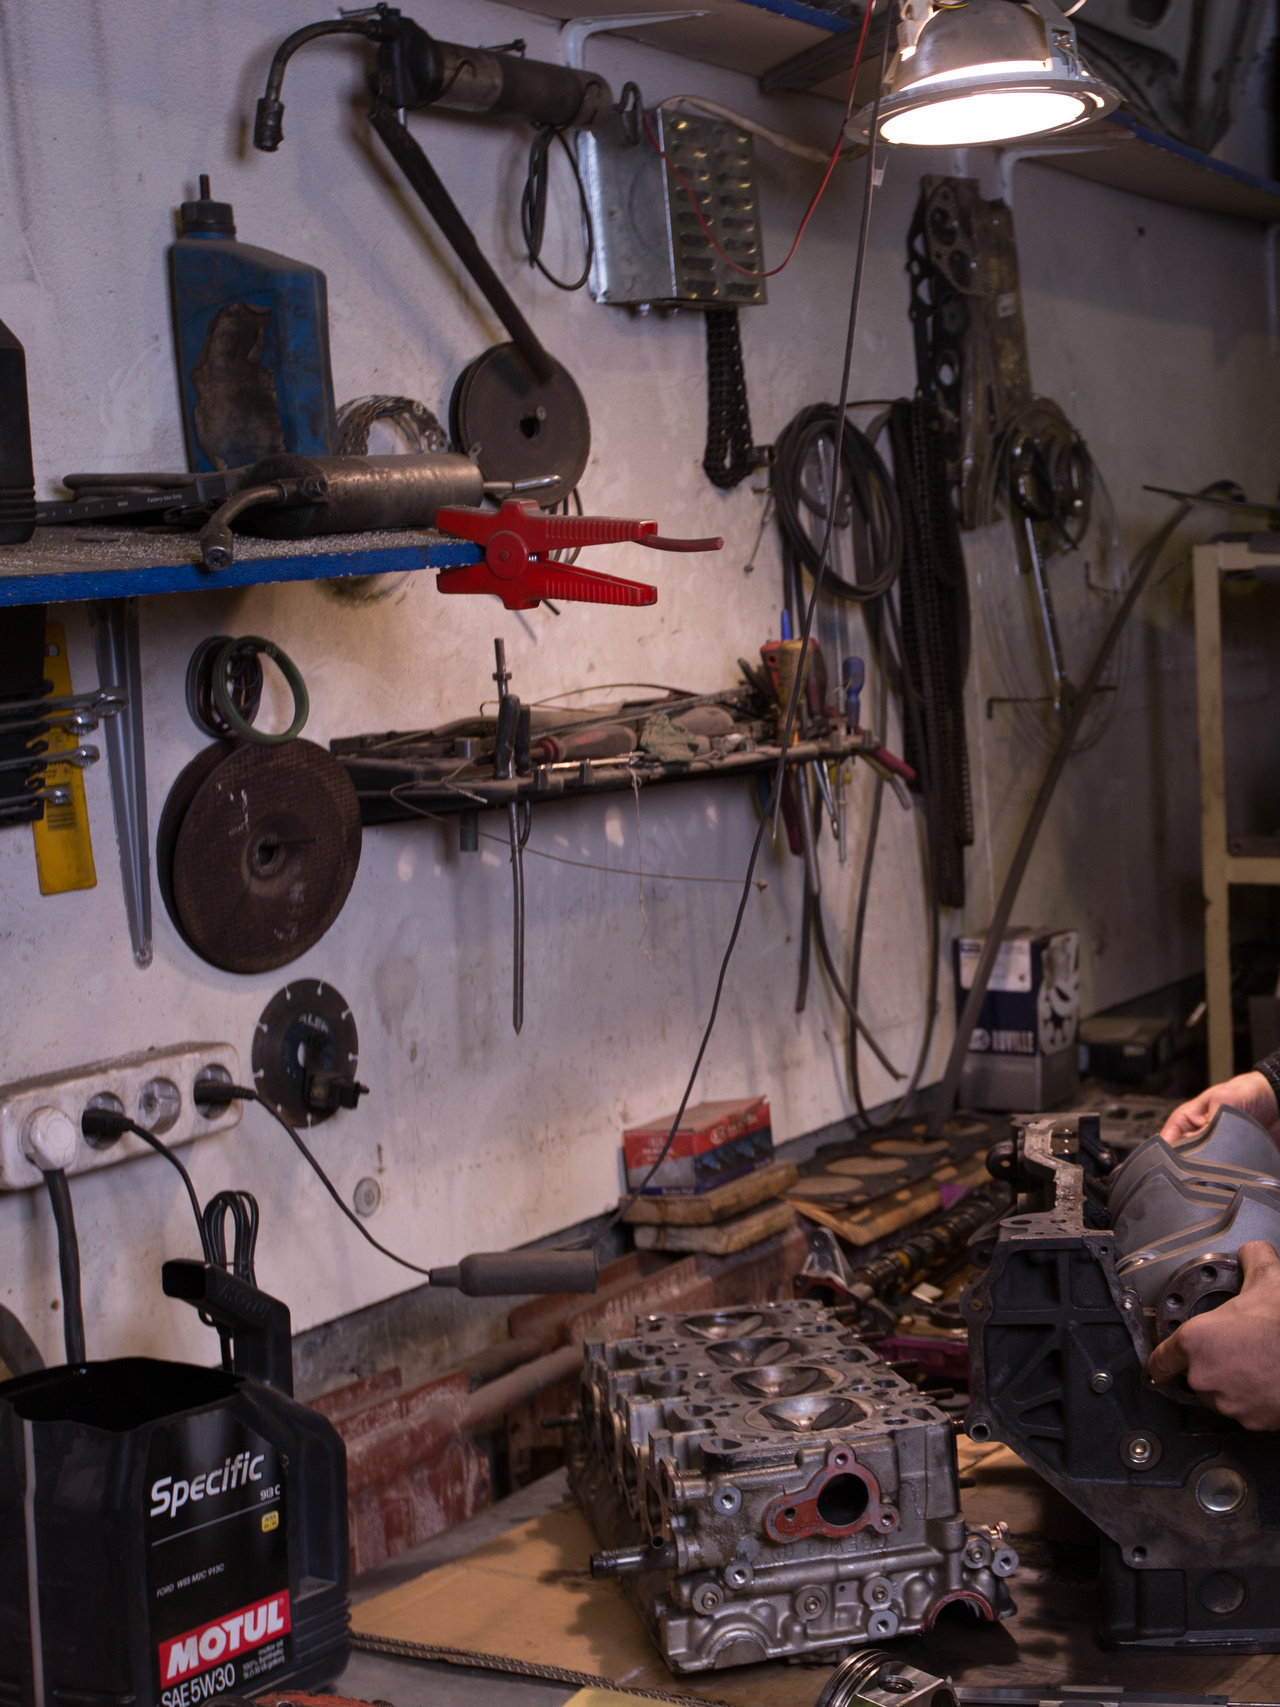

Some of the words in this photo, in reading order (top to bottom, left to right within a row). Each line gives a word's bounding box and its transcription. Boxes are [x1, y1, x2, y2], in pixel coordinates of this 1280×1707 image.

[150, 1450, 265, 1518] Specific
[156, 1583, 175, 1598] FORD
[207, 1562, 225, 1576] 913C
[166, 1600, 285, 1680] MOTUL
[161, 1682, 191, 1707] SAE
[190, 1662, 236, 1703] 5W30
